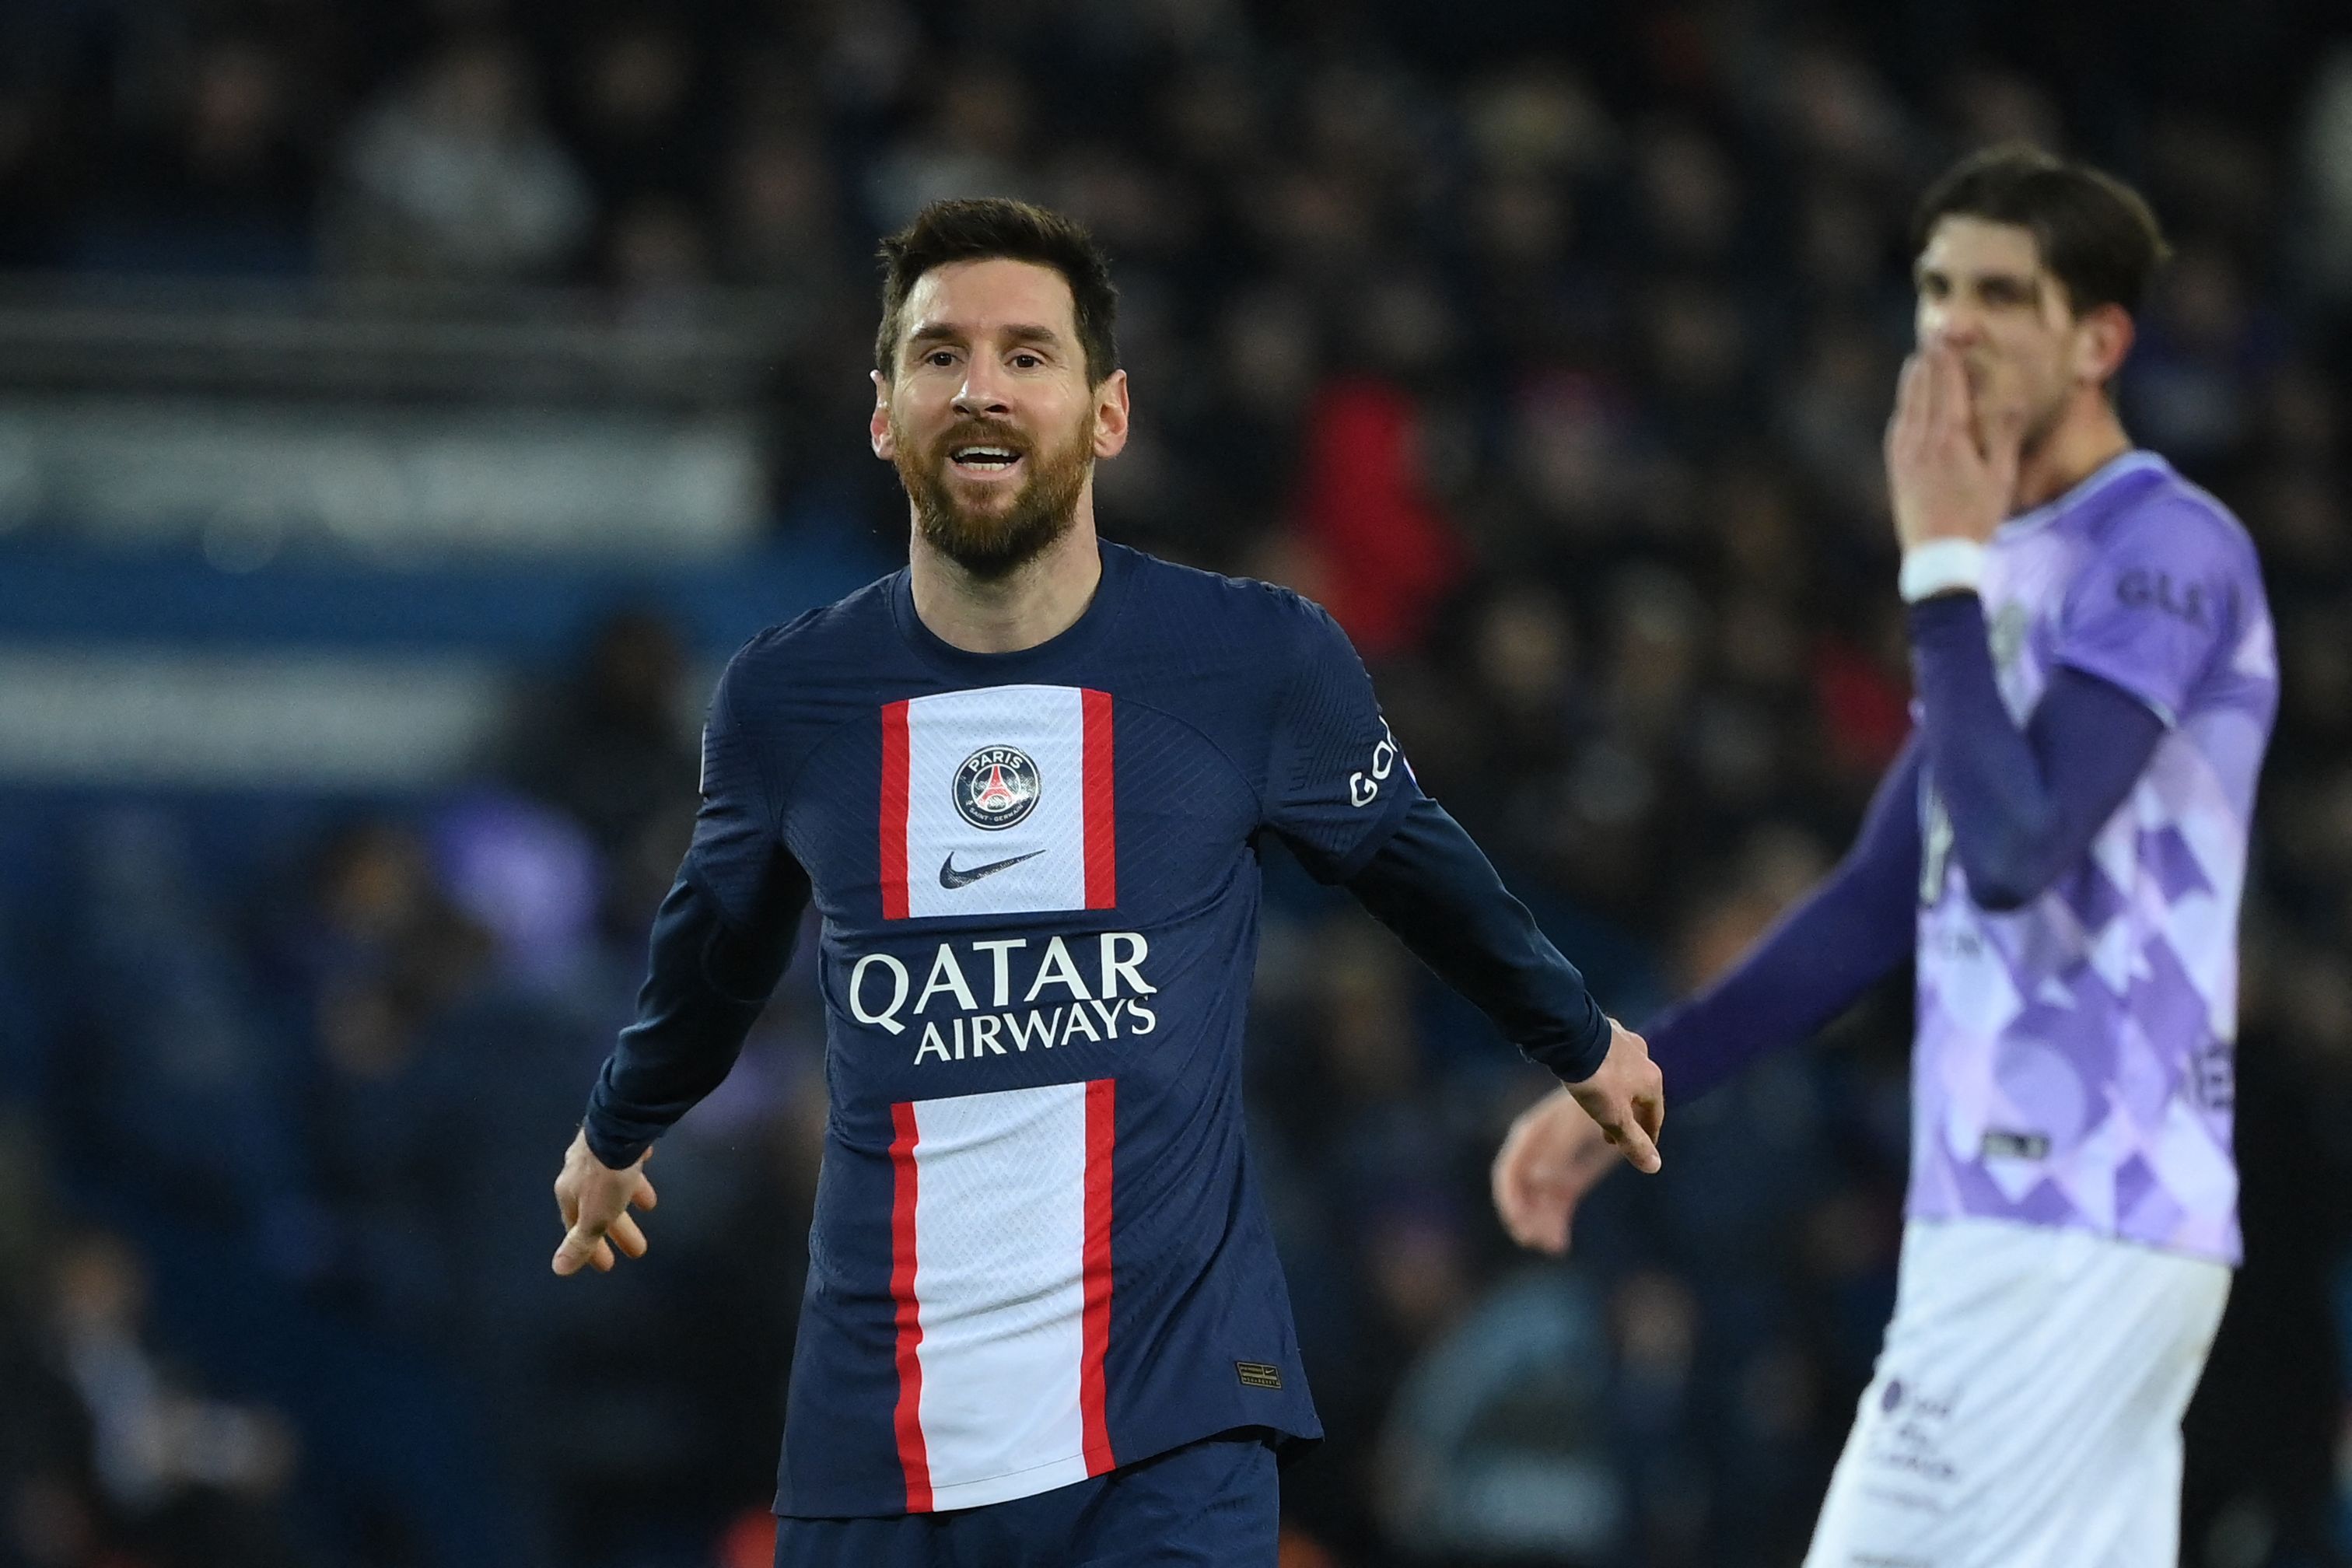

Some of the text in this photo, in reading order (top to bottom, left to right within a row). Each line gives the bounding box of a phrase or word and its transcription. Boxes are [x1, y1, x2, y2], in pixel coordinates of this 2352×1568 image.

[968, 751, 1024, 772] PARIS
[849, 932, 1158, 1035] QATAR
[913, 995, 1157, 1066] AIRWAYS
